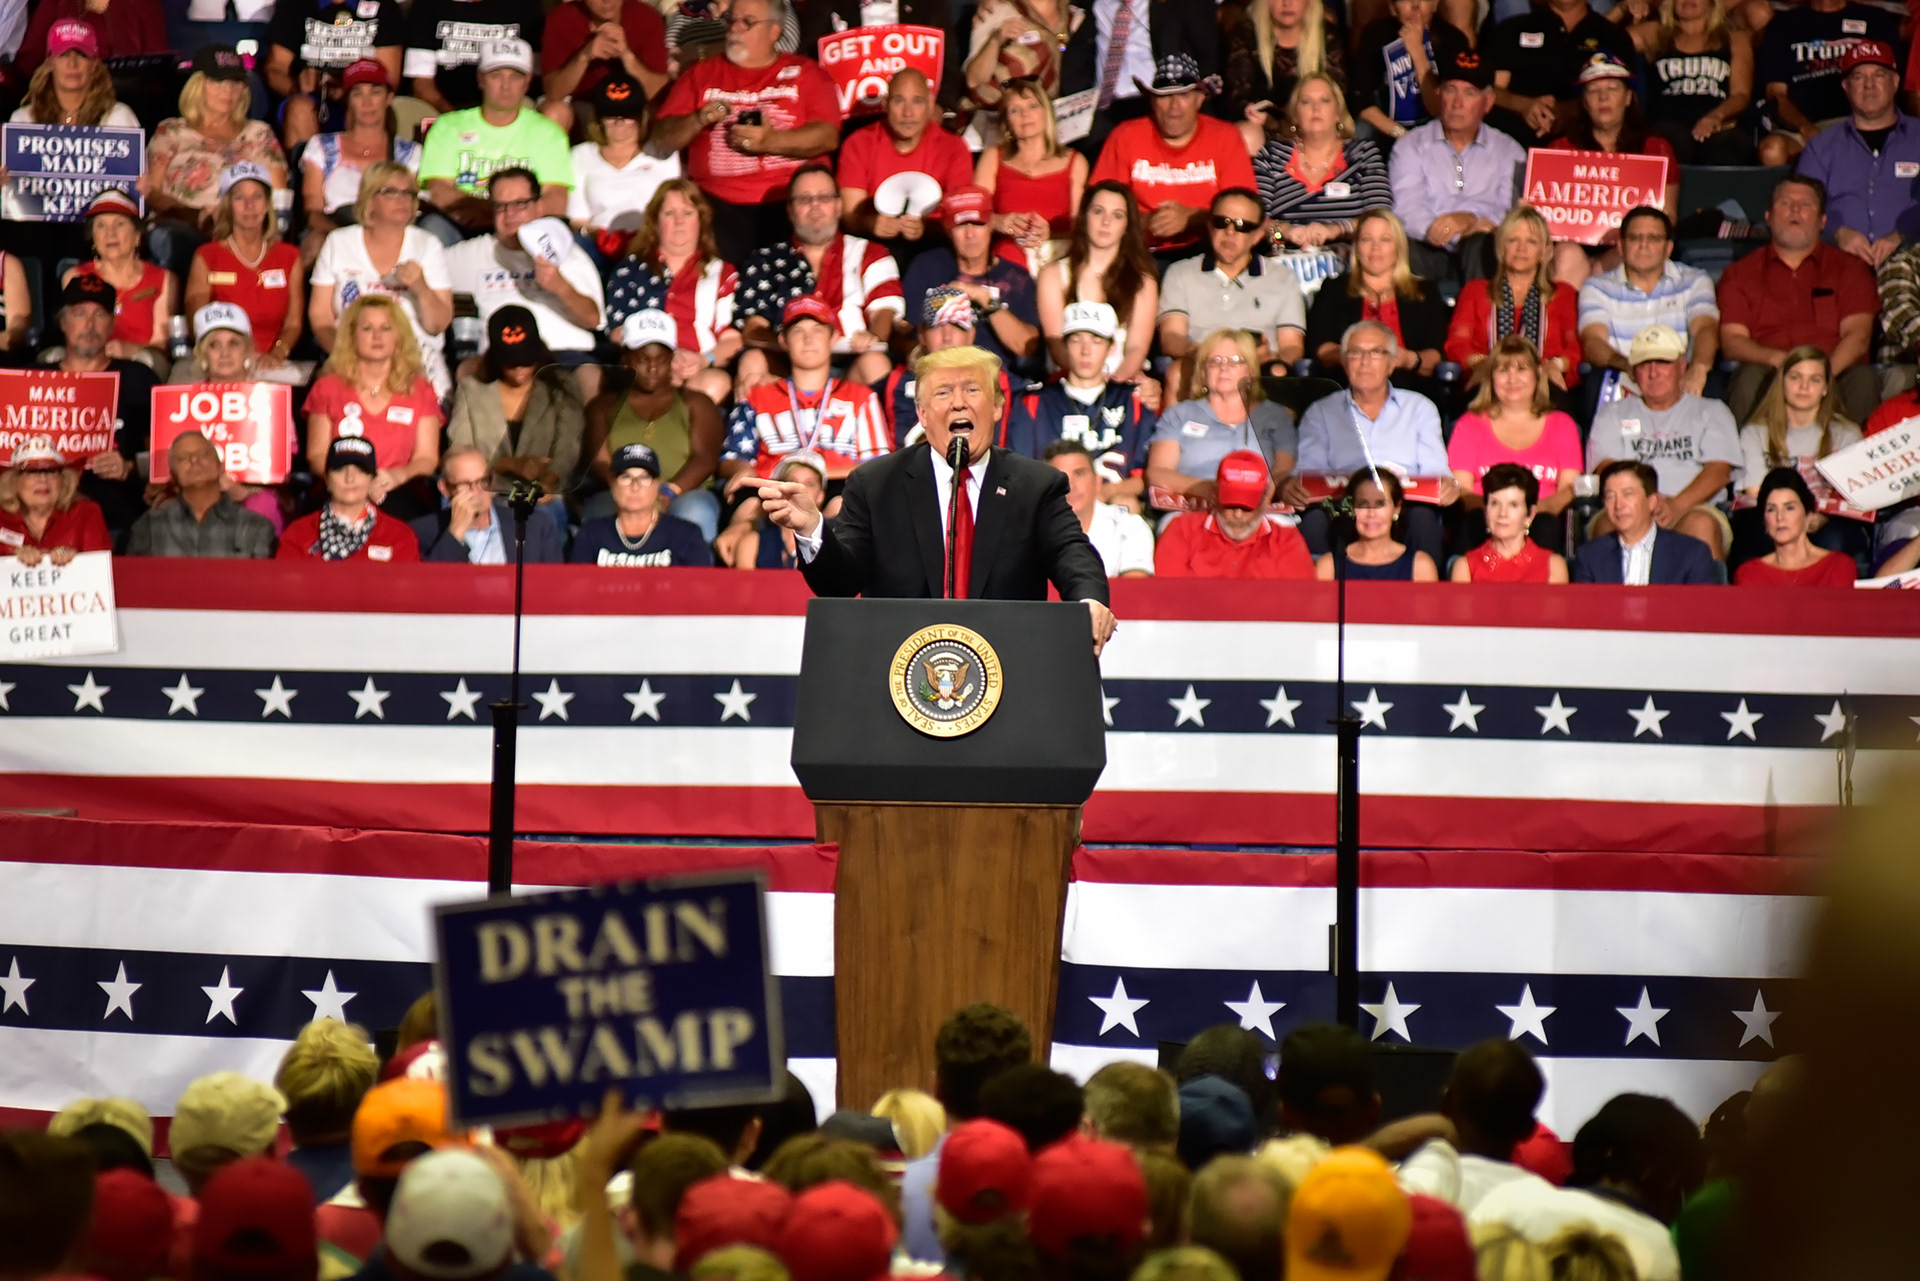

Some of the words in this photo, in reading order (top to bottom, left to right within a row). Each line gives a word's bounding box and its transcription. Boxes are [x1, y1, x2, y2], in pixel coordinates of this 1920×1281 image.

[823, 36, 877, 64] GET
[883, 33, 941, 59] OUT
[1852, 43, 1882, 60] USA
[860, 57, 906, 74] AND
[1657, 56, 1730, 82] TRUMP
[18, 135, 130, 159] PROMISES
[41, 154, 107, 175] MADE
[1572, 164, 1620, 181] MAKE
[43, 194, 88, 214] KEP
[1529, 180, 1661, 208] AMERICA
[640, 317, 667, 331] USA
[29, 386, 76, 403] MAKE
[57, 434, 108, 452] AGAIN
[1866, 432, 1912, 460] KEEP
[11, 570, 62, 588] KEEP
[0, 590, 107, 619] MERICA
[10, 622, 73, 644] GREAT
[961, 632, 975, 644] THE
[894, 629, 945, 677] PRESIDENT
[976, 643, 998, 689] UNITED
[900, 697, 908, 708] OF
[955, 698, 993, 731] STATES
[907, 707, 935, 731] SEAL
[478, 899, 727, 982] DRAIN
[560, 971, 653, 1018] THE
[467, 1008, 755, 1096] SWAMP
